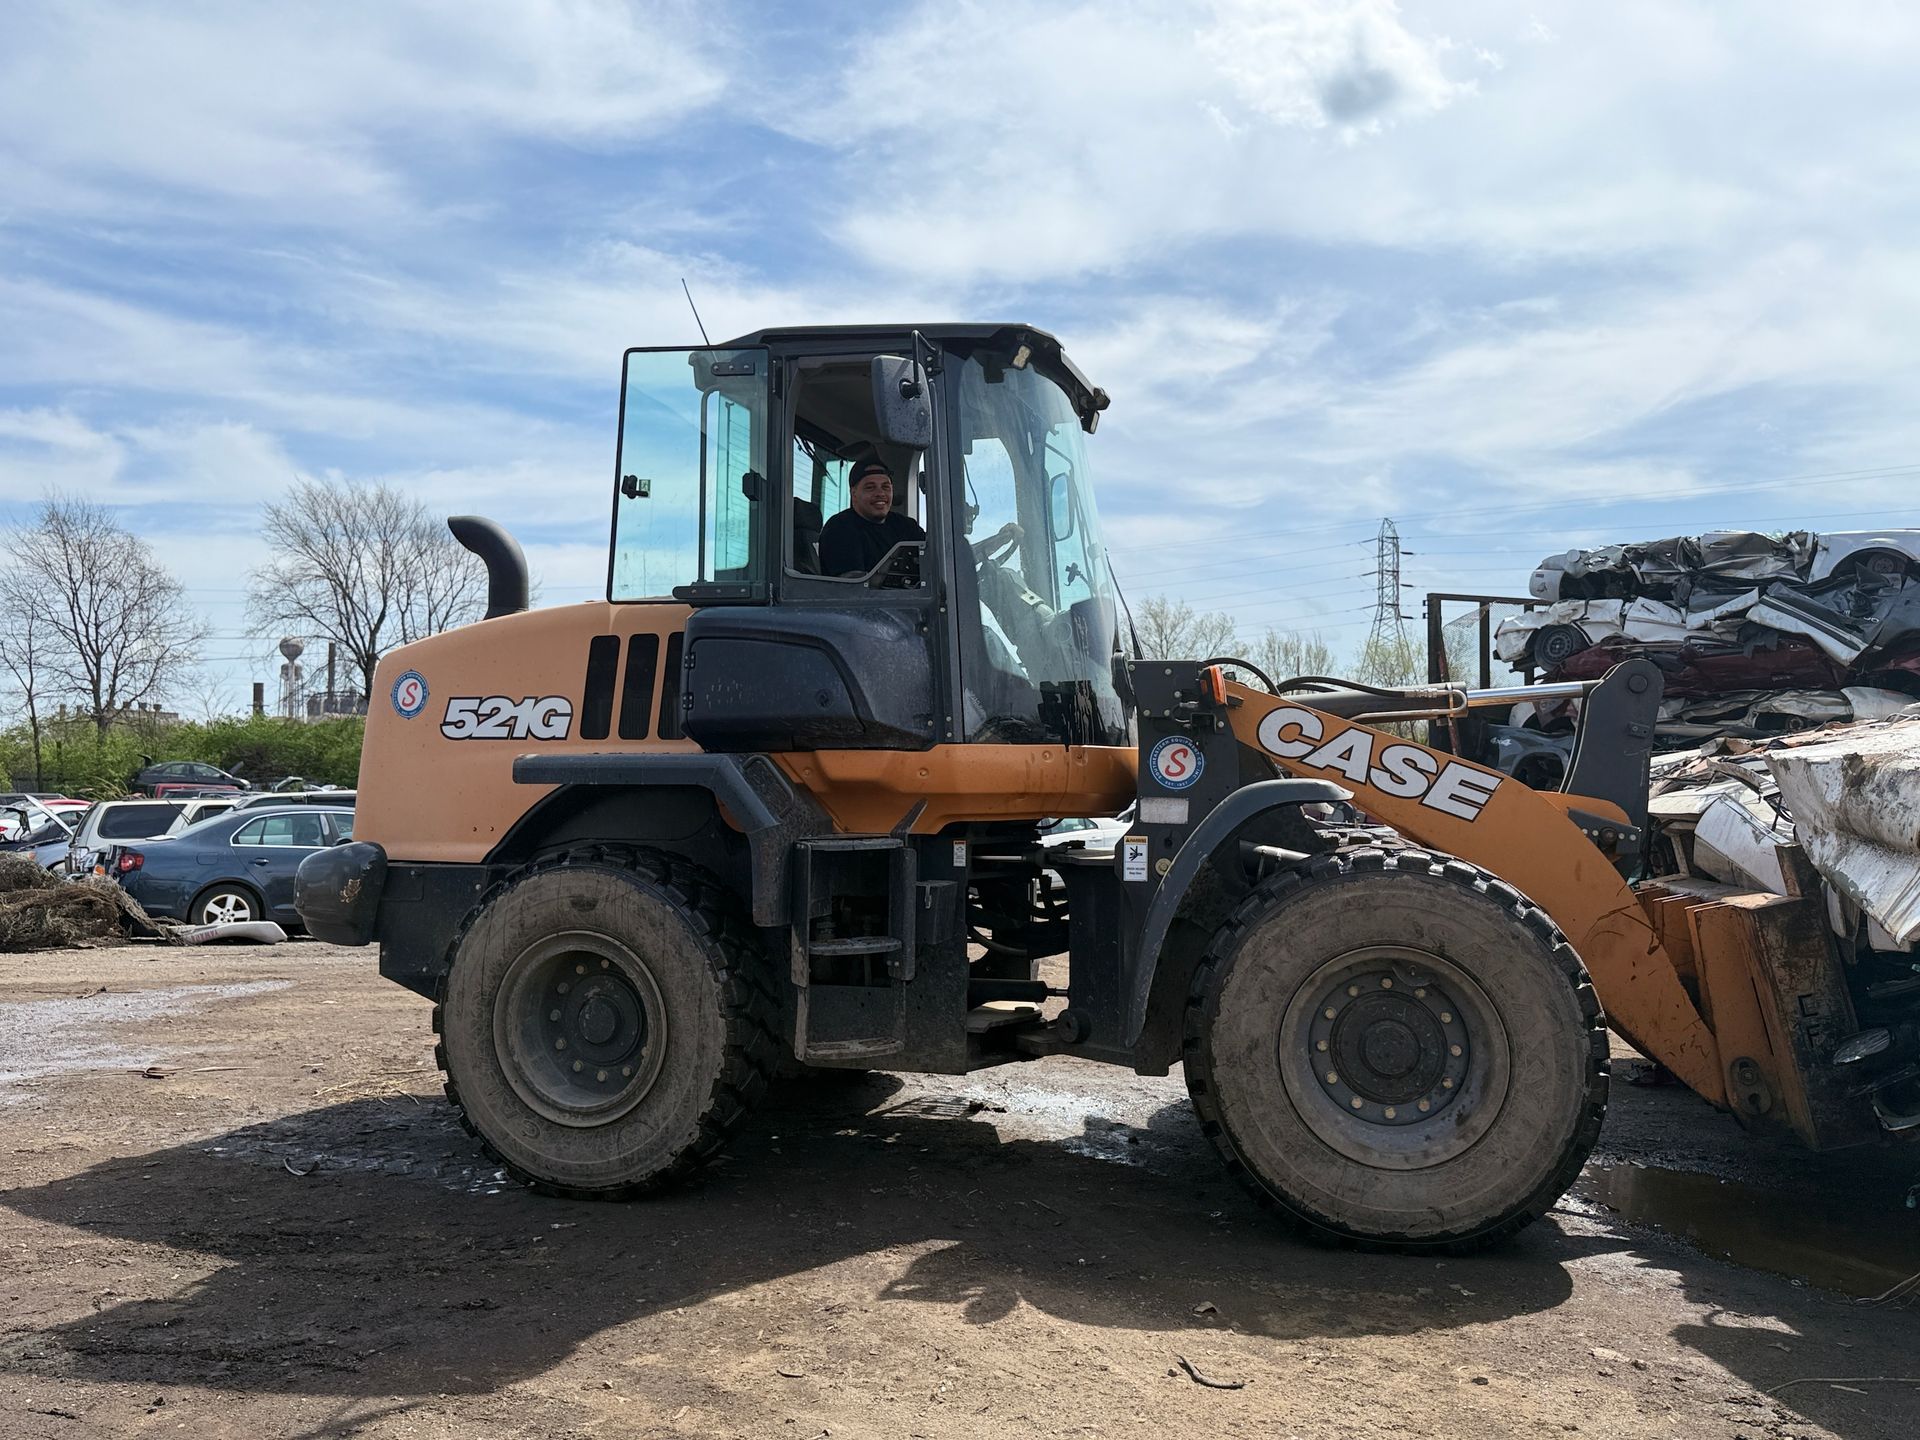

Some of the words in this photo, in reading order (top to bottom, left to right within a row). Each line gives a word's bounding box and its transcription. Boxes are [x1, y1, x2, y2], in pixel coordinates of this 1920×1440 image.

[401, 681, 418, 707] S
[440, 695, 573, 740] 521G
[1164, 748, 1188, 777] S
[1256, 705, 1504, 823] CASE
